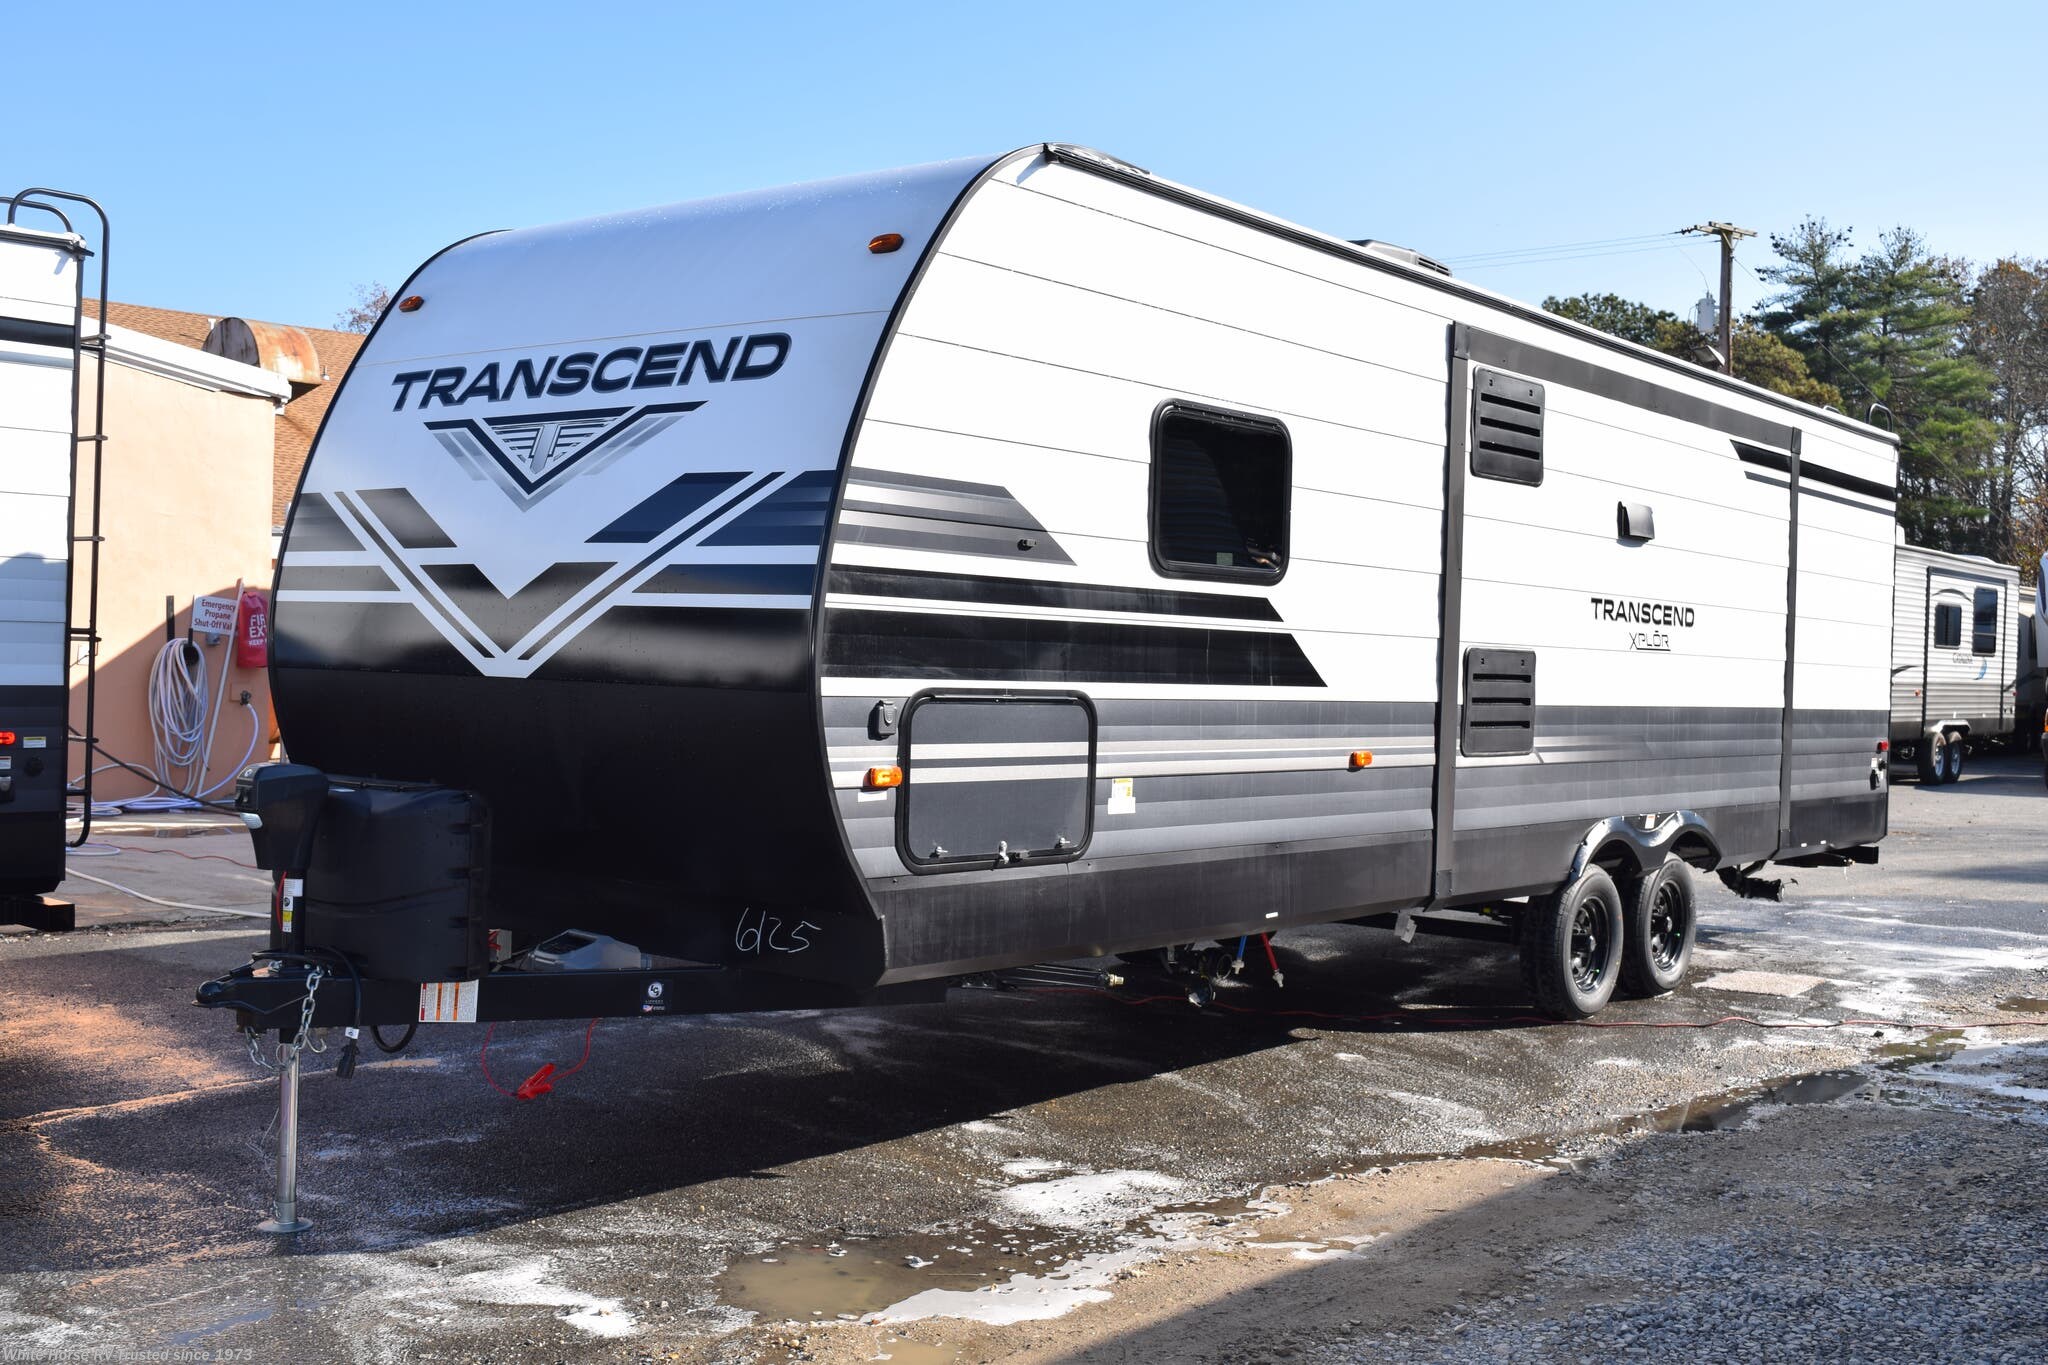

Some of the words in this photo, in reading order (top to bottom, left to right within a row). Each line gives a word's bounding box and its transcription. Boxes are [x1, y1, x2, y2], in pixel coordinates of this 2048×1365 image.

[392, 332, 792, 412] TRANSCEND
[201, 599, 236, 612] Emergency
[1591, 597, 1694, 627] TRANSCEND
[204, 609, 231, 620] Propane
[250, 613, 265, 626] FIR
[194, 618, 222, 629] Shut-Off
[222, 621, 233, 631] Val
[736, 907, 822, 954] 6125
